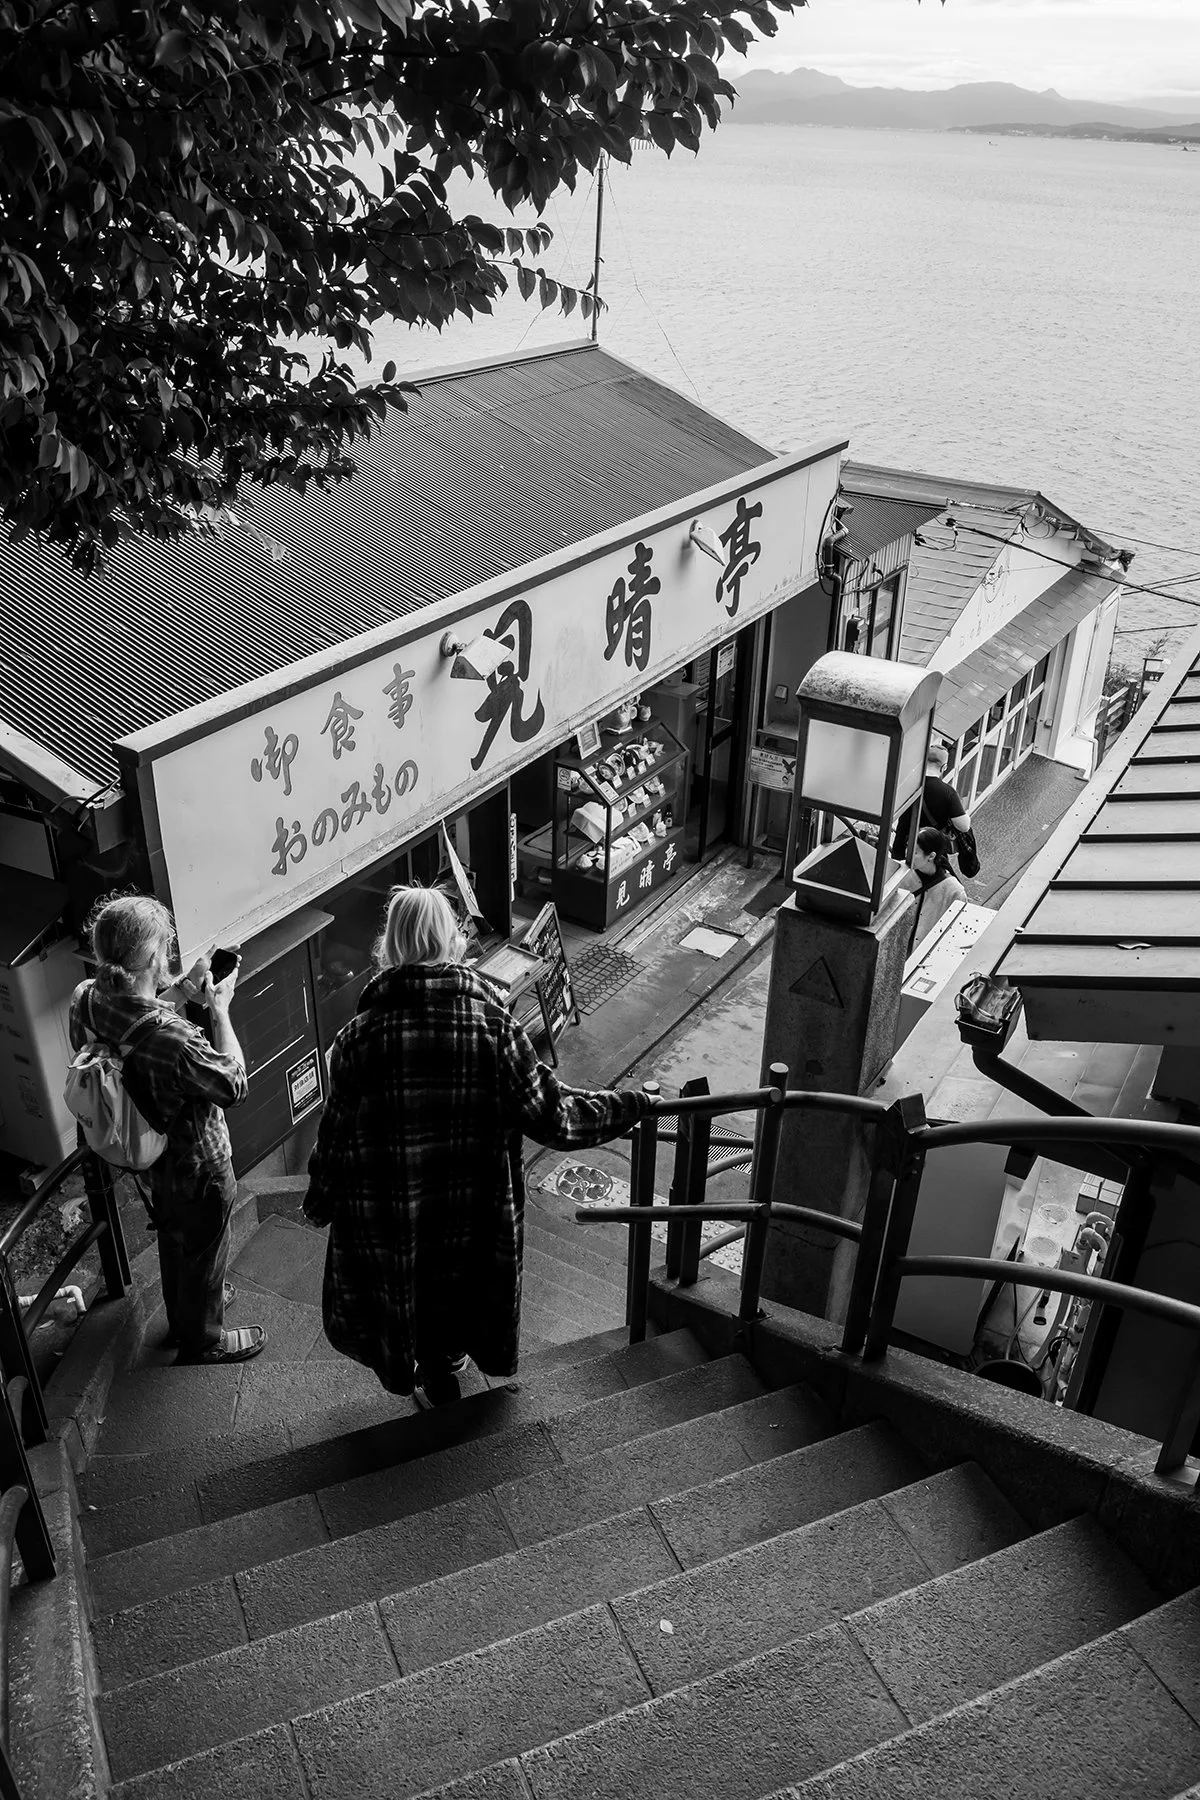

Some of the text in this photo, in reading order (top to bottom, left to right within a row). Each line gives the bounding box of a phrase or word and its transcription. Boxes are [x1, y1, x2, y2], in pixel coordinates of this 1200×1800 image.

[470, 496, 763, 771] 見晴亭
[250, 662, 416, 796] 御食事
[271, 759, 419, 876] おのみもの
[616, 842, 677, 909] 見晴亭
